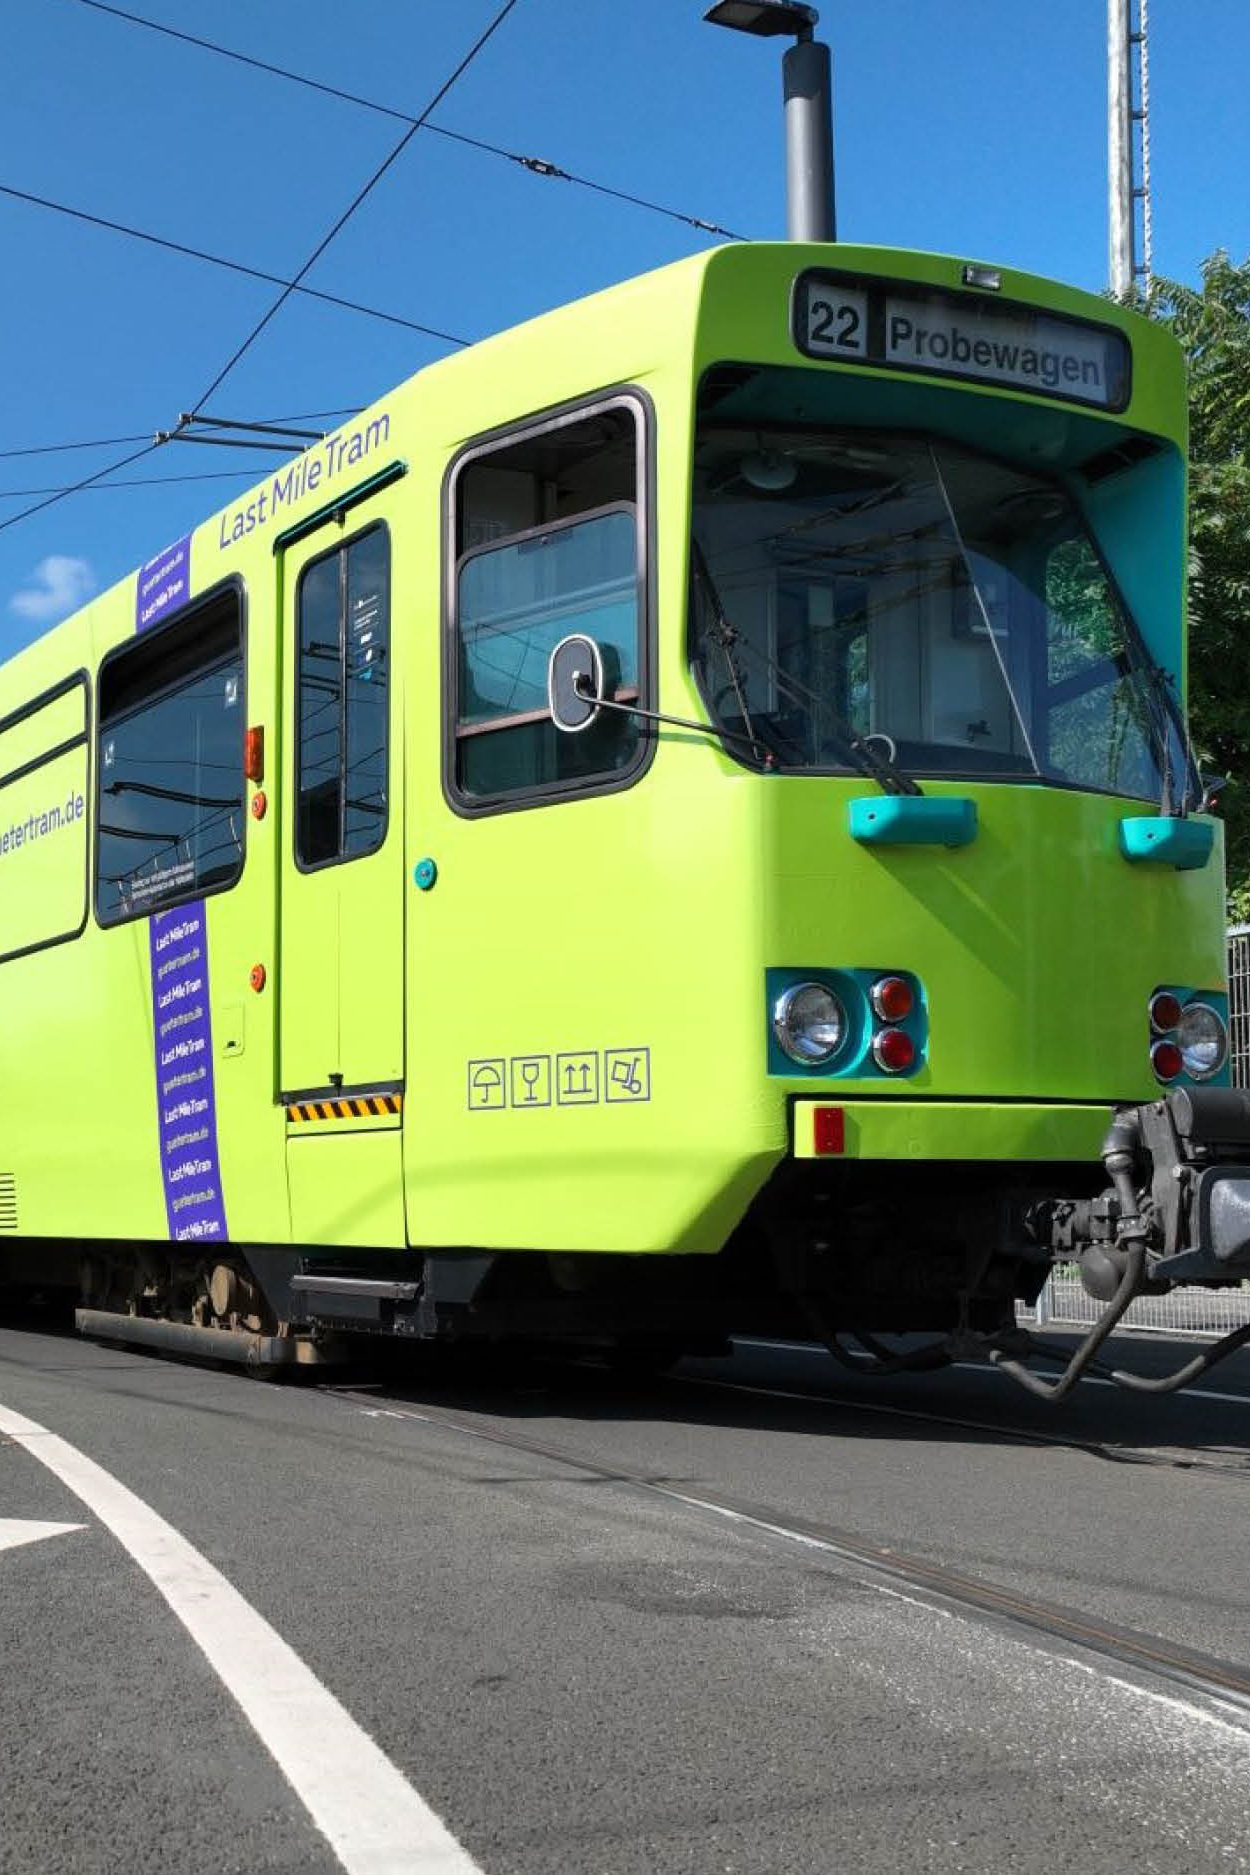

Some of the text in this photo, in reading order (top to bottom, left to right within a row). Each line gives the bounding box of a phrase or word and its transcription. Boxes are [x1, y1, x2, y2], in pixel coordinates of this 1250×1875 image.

[811, 301, 860, 348] 22
[890, 317, 1100, 387] Probewagen
[219, 413, 391, 550] Last Mile Tram
